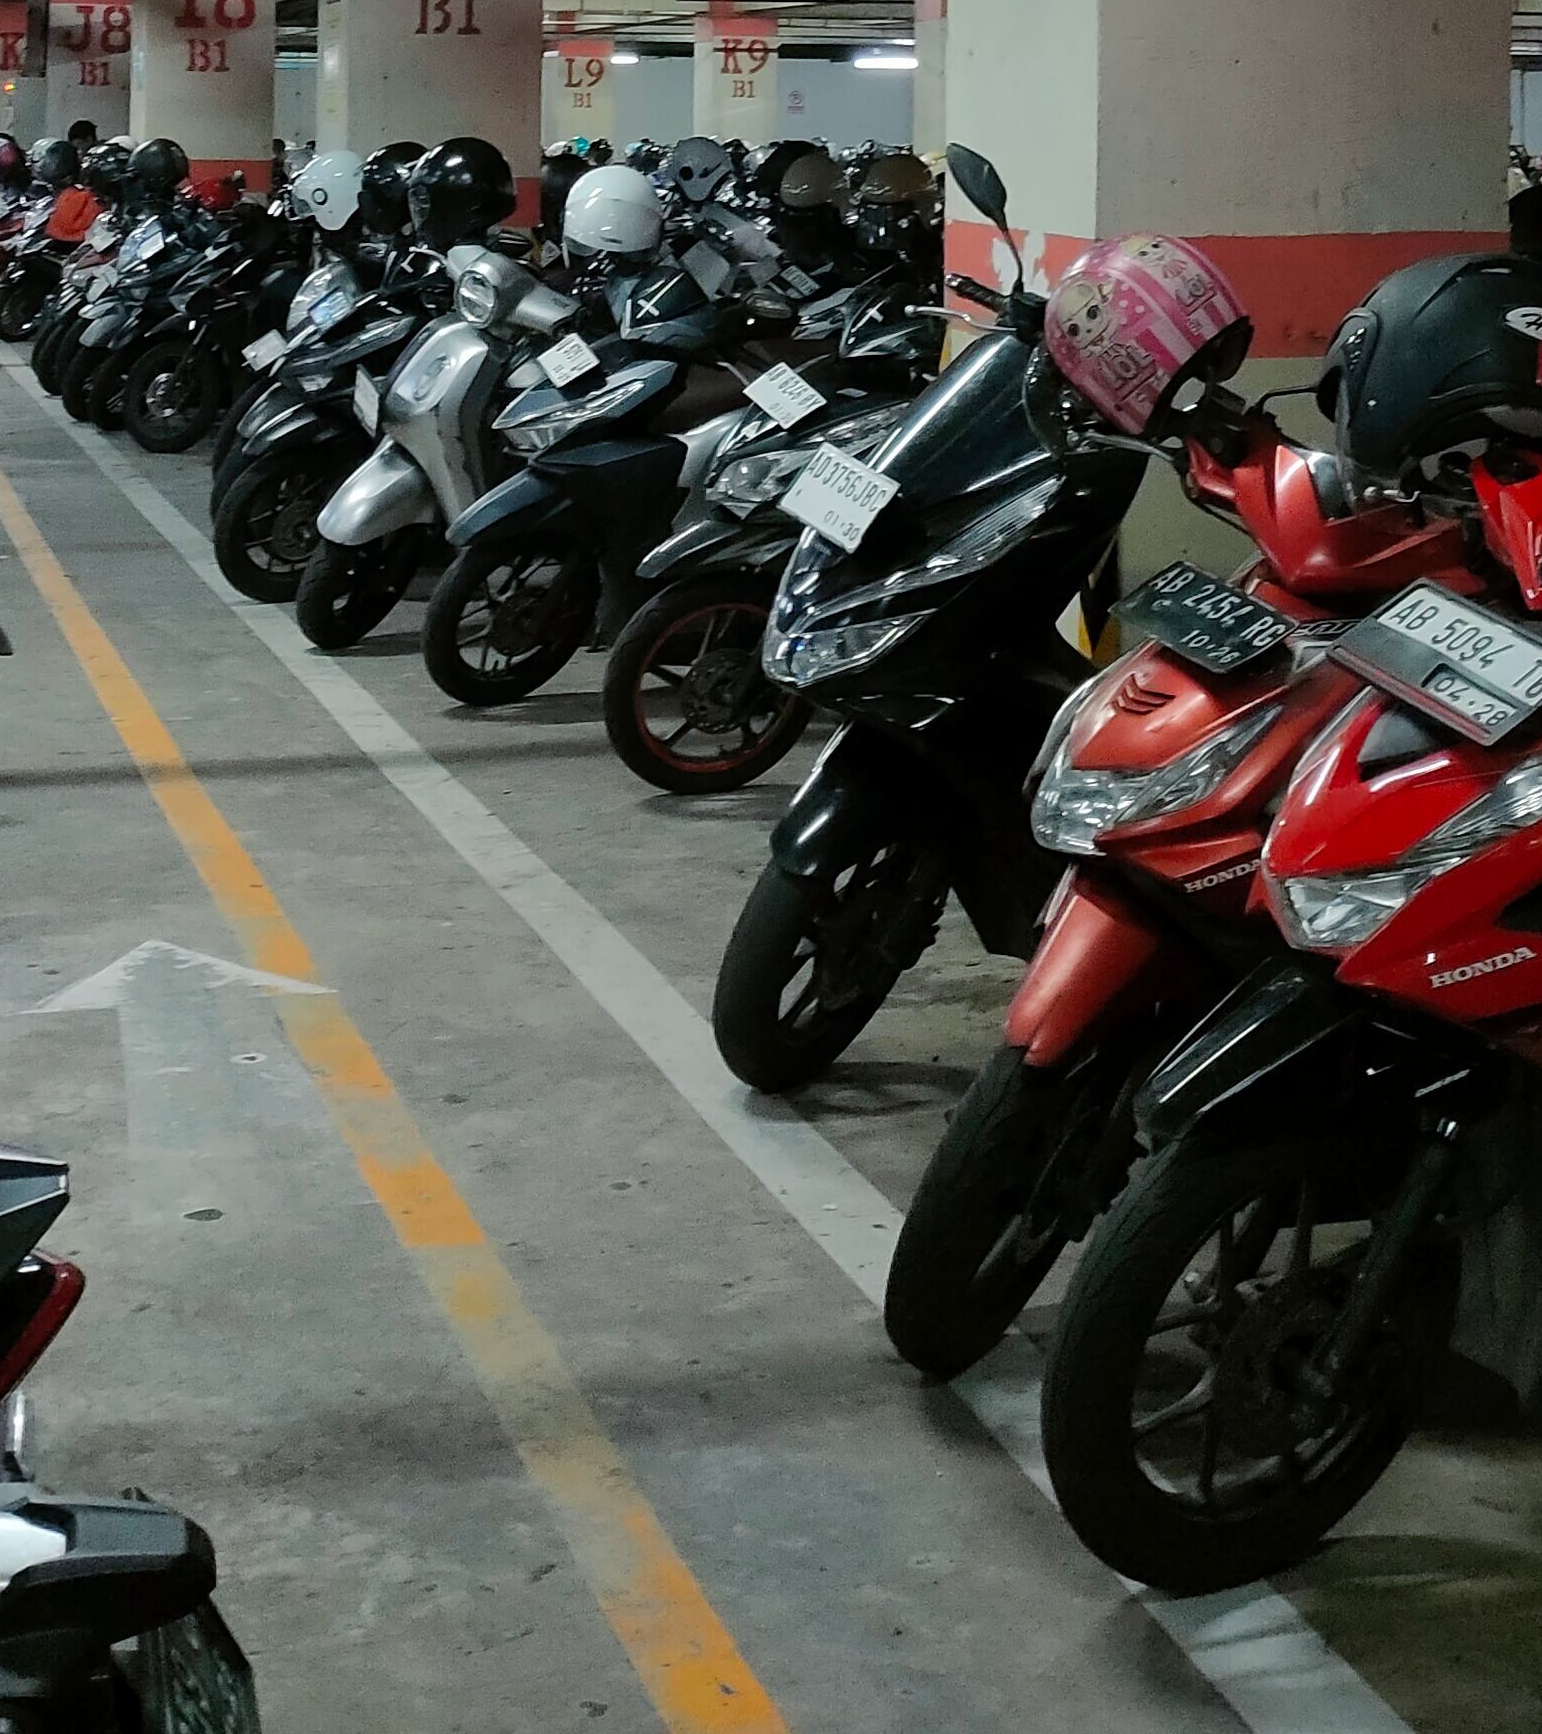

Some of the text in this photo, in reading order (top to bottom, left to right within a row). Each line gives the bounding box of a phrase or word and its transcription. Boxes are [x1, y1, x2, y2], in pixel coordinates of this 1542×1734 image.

[59, 5, 132, 54] J8
[78, 61, 111, 86] B1
[186, 39, 232, 74] B1
[563, 57, 605, 89] L9
[719, 38, 770, 75] K9
[571, 92, 594, 109] B1
[730, 79, 756, 99] B1
[1149, 568, 1196, 594] AB
[1182, 584, 1255, 628] 2454
[1388, 599, 1440, 631] AB
[1431, 621, 1514, 670] 5094
[1428, 946, 1538, 989] HONDA
